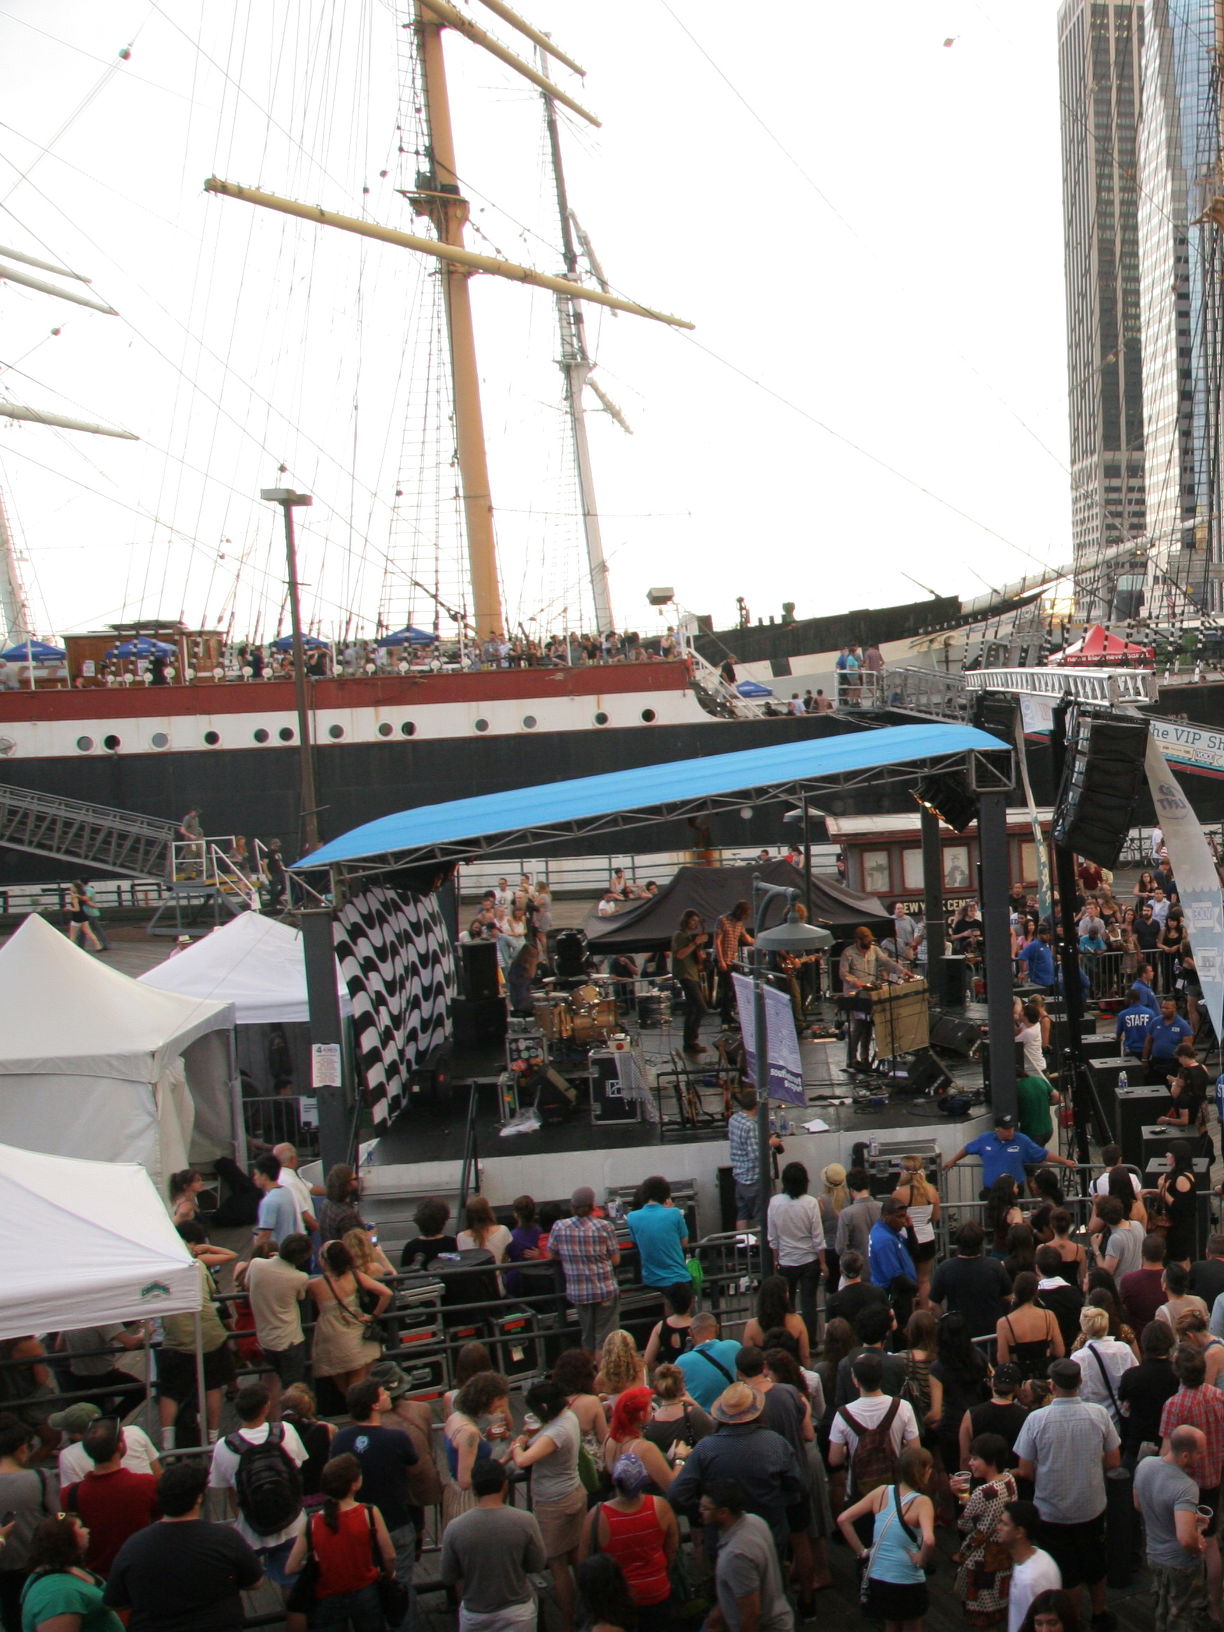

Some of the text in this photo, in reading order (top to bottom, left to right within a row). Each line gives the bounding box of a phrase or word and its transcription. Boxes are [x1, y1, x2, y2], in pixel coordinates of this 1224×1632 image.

[1152, 724, 1169, 739] he
[1174, 728, 1202, 745] VIP
[903, 902, 919, 913] EW
[1125, 1014, 1149, 1027] STAFF
